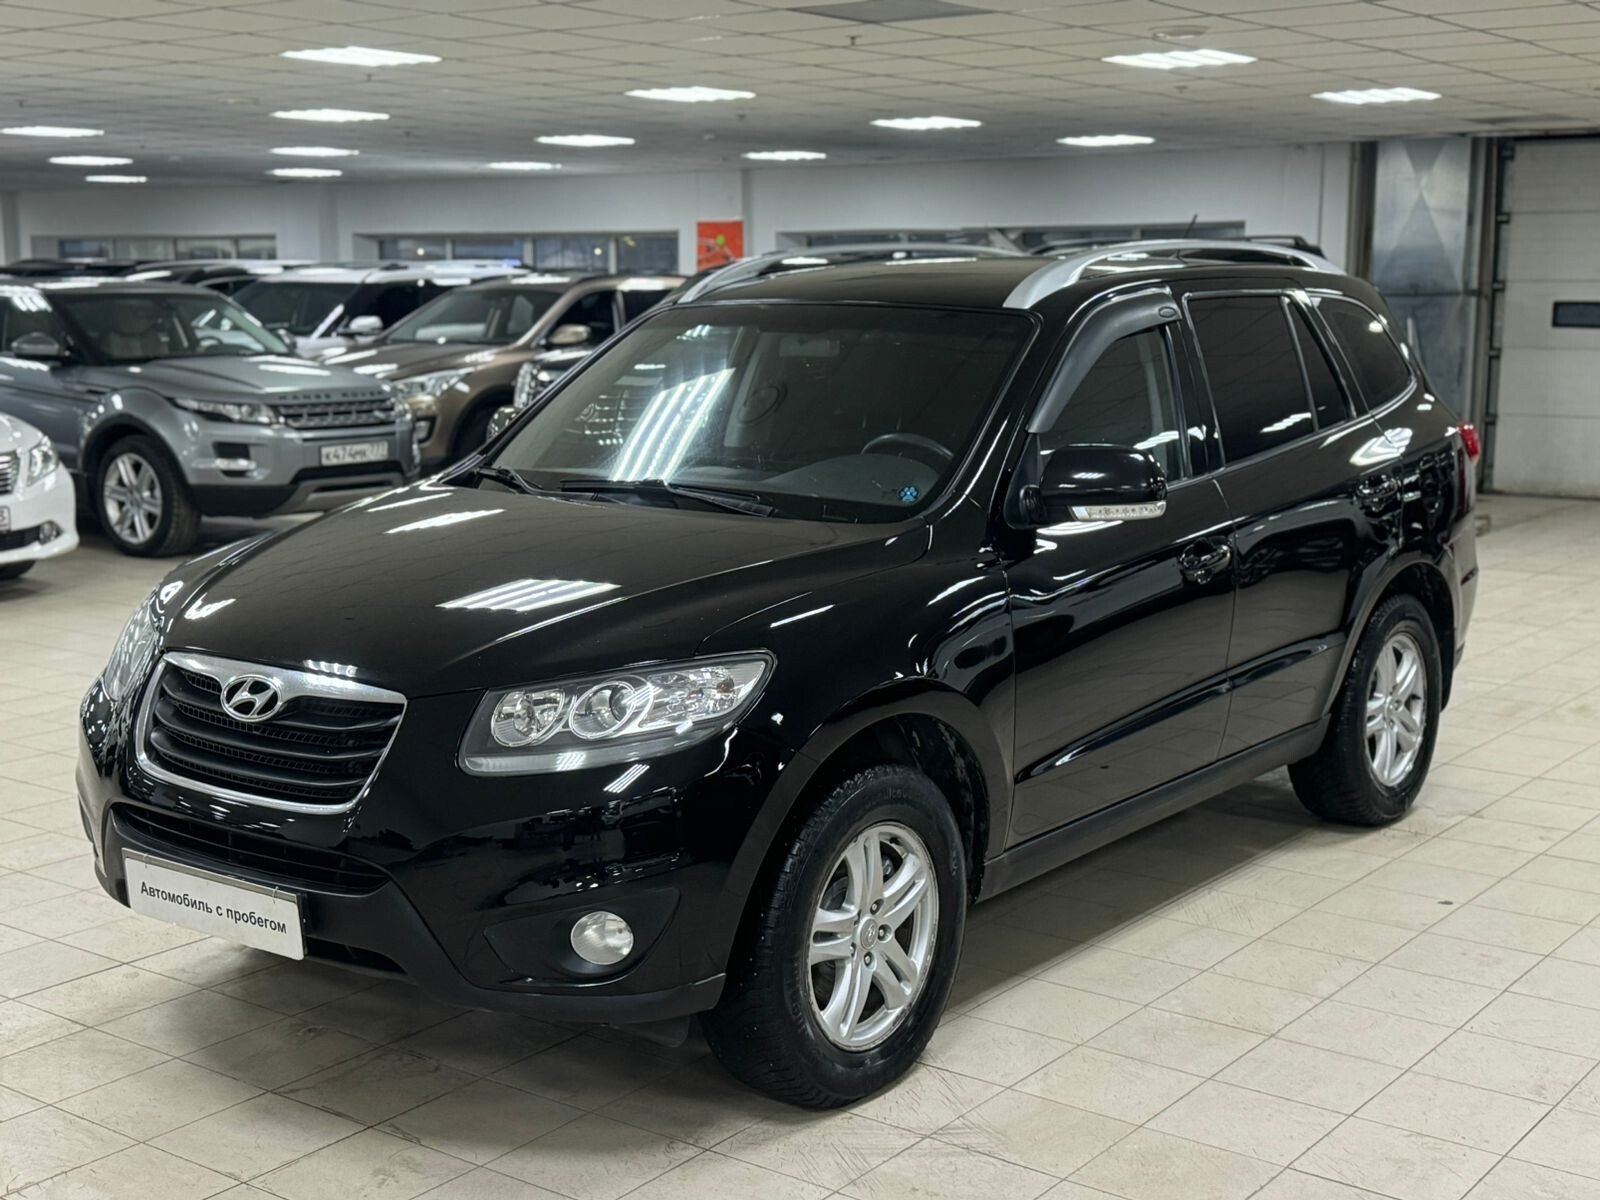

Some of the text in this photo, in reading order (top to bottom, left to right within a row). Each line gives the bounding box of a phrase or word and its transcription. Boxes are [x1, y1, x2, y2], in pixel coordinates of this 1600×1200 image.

[140, 881, 287, 934] Автомобиль с пробегом
